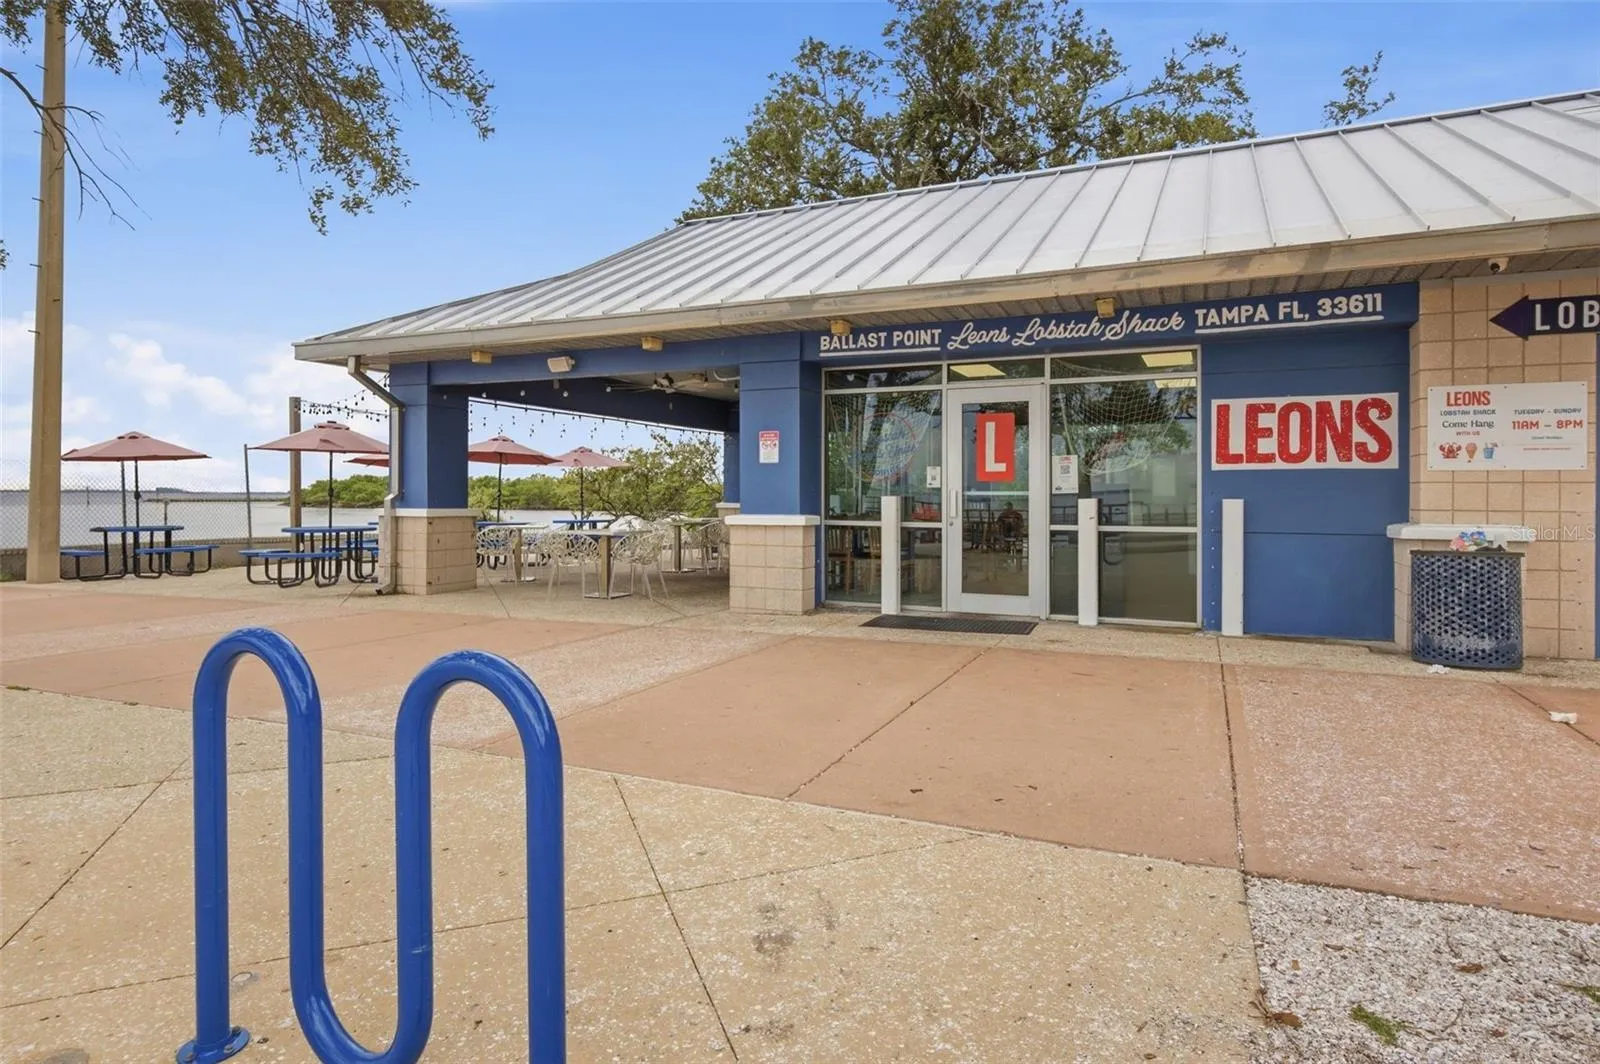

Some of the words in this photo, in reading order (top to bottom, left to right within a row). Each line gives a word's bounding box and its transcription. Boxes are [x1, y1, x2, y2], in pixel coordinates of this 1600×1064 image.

[819, 332, 888, 351] BALLAST
[893, 328, 942, 347] POINT
[947, 321, 1010, 350] Leons
[1011, 316, 1104, 346] Lobstah
[1100, 310, 1186, 341] Shack
[1195, 303, 1269, 327] TAMPA
[1278, 301, 1310, 321] FL,
[1317, 293, 1382, 316] 33611
[1535, 300, 1600, 331] LOB
[1446, 391, 1491, 407] LEONS
[1215, 398, 1393, 464] LEONS
[1442, 420, 1468, 428] Come
[1471, 419, 1495, 429] Hang
[1512, 420, 1540, 430] 11AM
[1556, 419, 1584, 429] 8PM
[985, 422, 1006, 472] L
